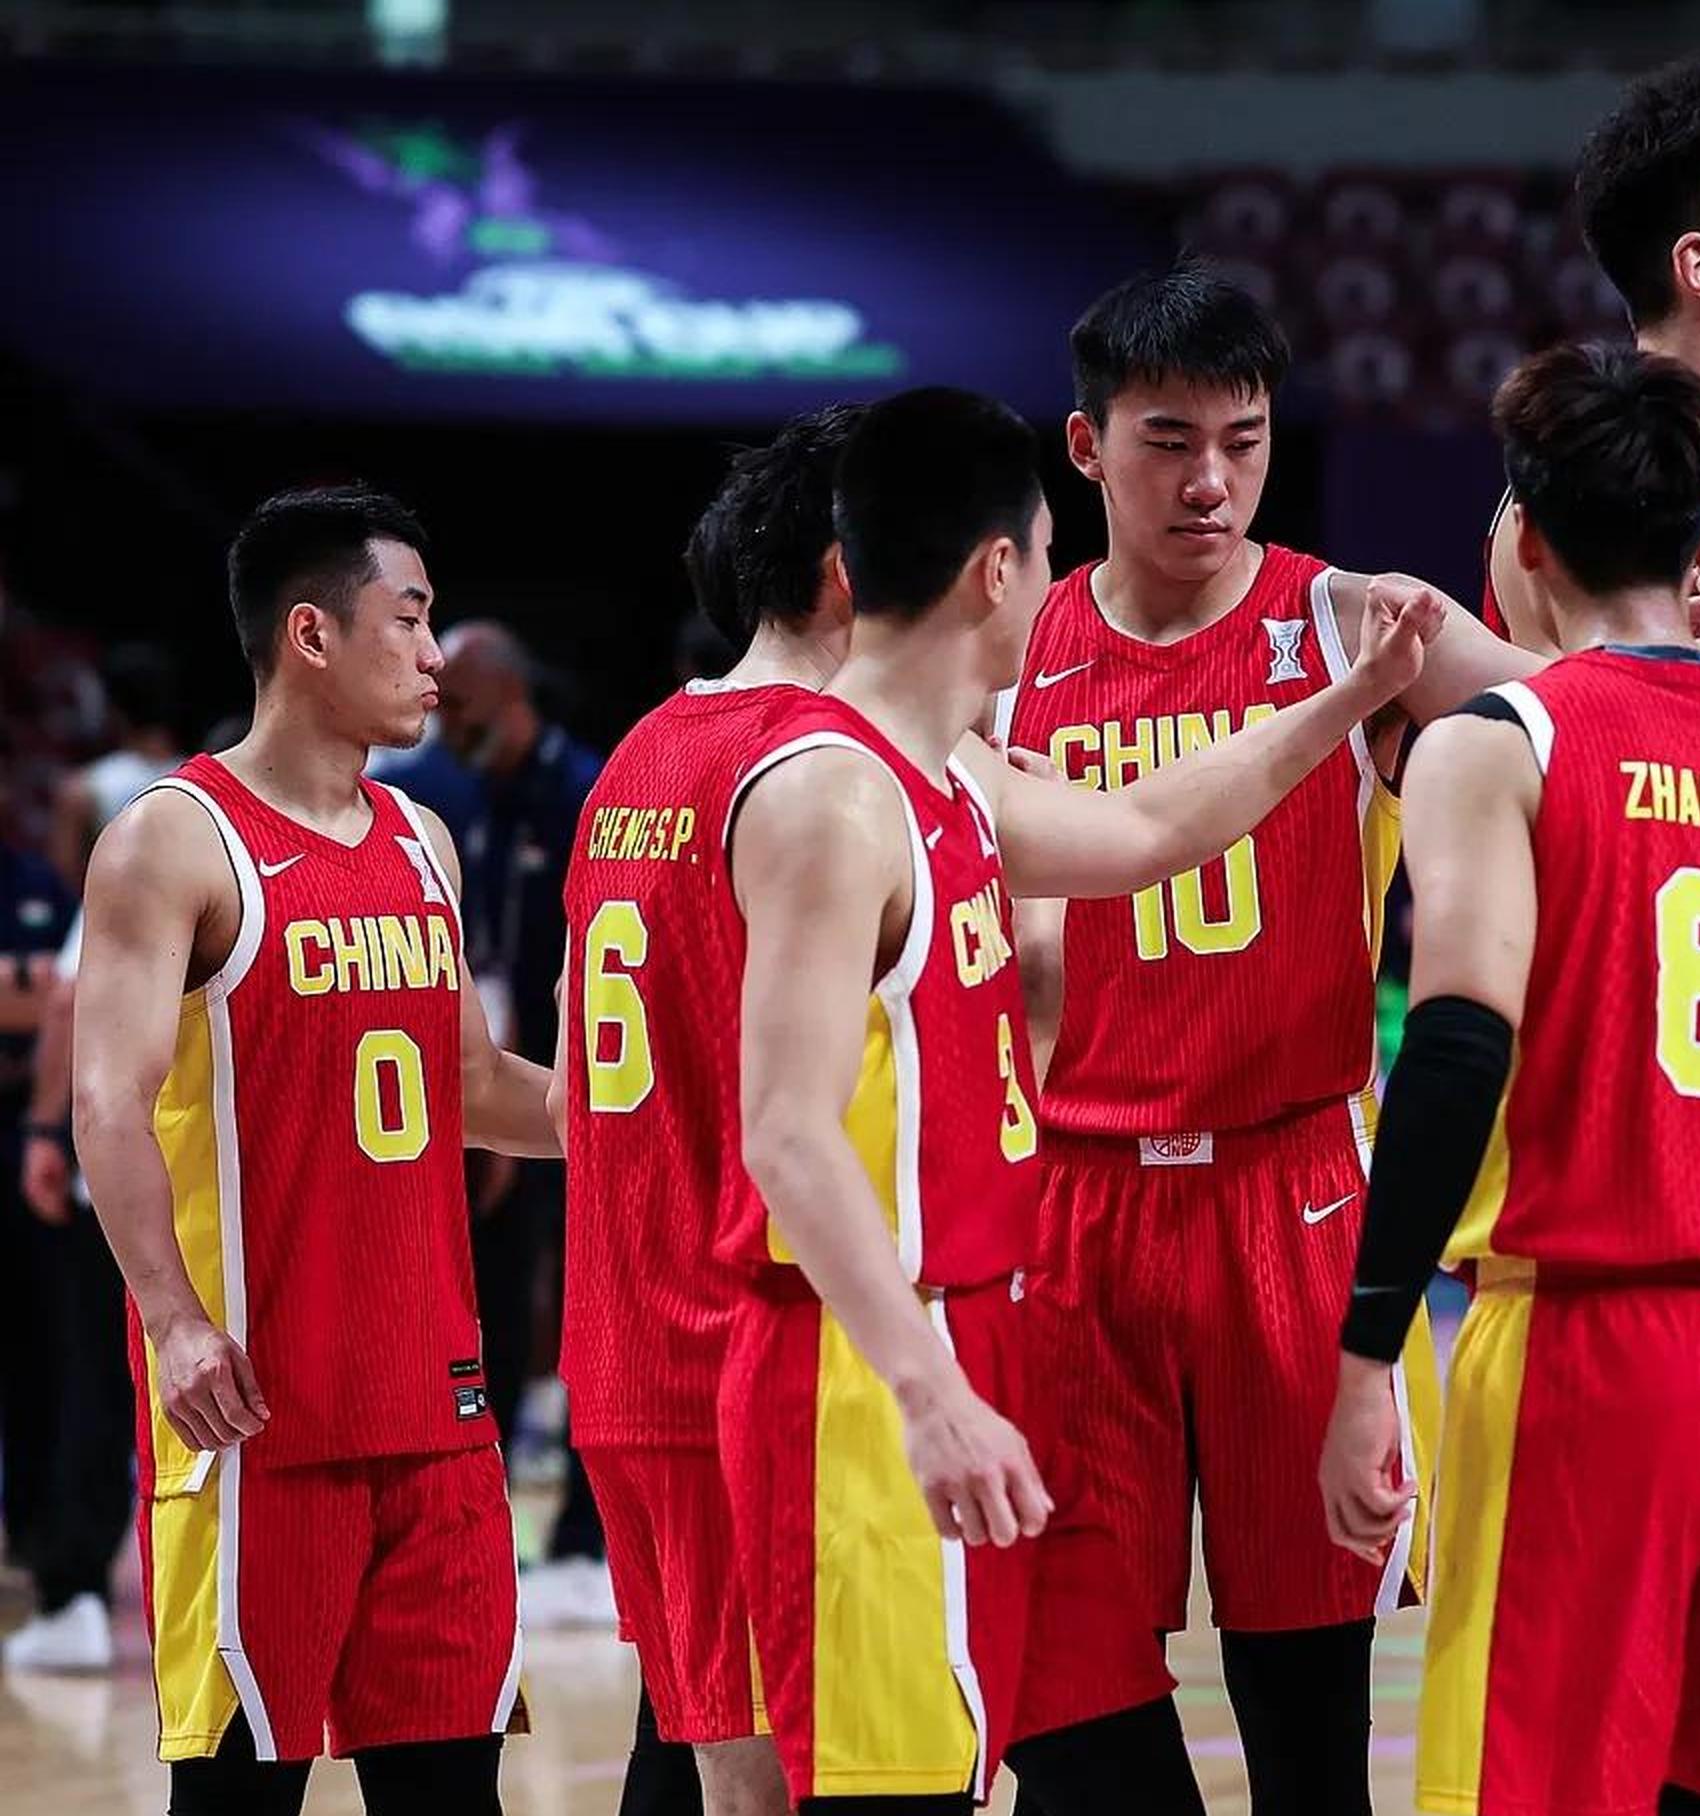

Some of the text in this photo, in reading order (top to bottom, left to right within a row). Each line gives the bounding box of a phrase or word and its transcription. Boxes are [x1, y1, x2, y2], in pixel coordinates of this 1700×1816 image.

[285, 916, 458, 995] CHINA
[584, 901, 654, 1113] 6
[353, 1029, 430, 1163] 0
